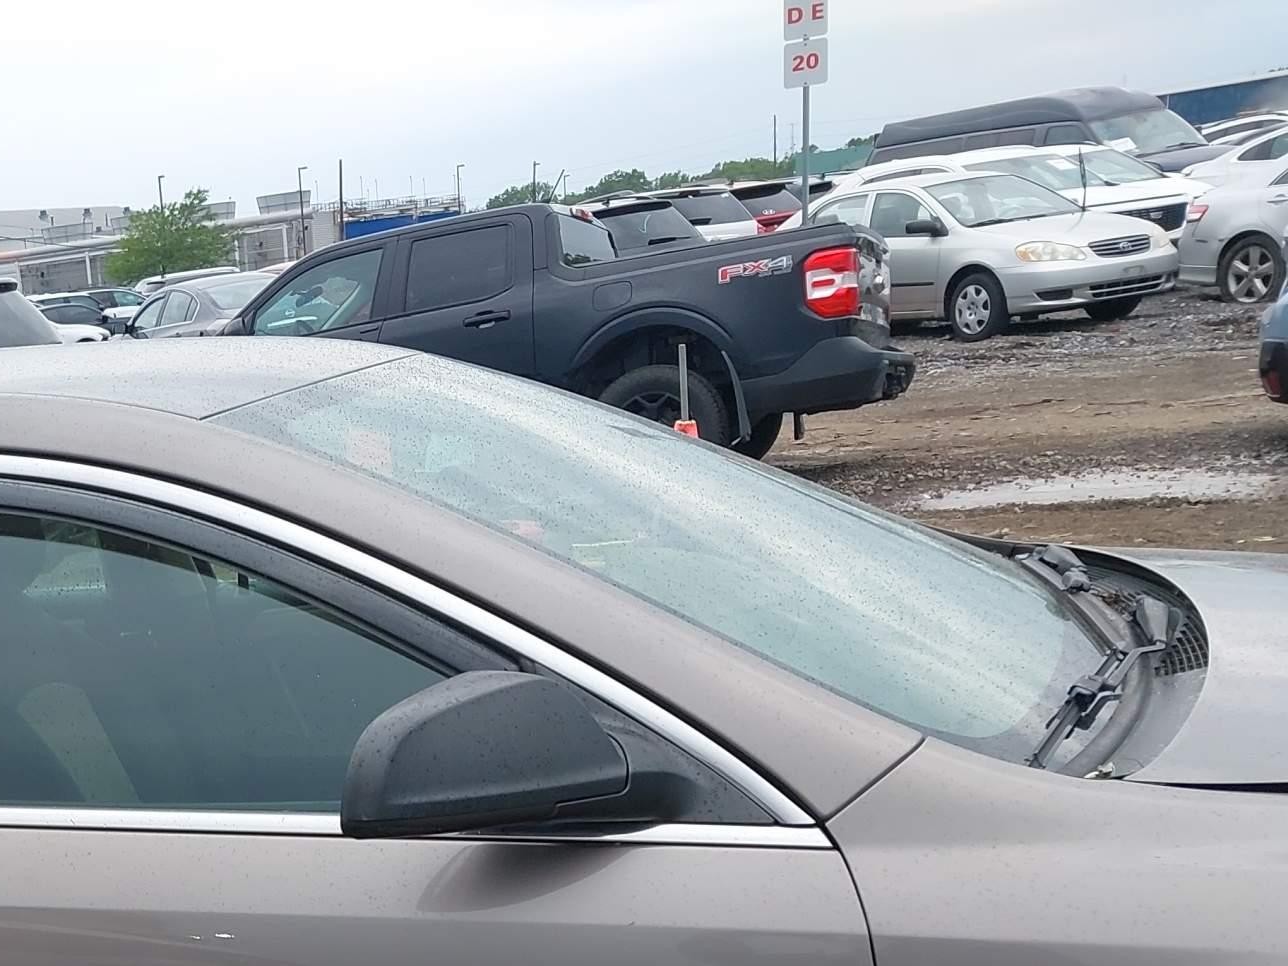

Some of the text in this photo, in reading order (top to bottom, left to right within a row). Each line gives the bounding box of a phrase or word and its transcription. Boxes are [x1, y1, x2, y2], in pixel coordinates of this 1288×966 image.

[787, 2, 825, 25] D E
[792, 52, 819, 72] 20
[718, 255, 792, 285] FX4
